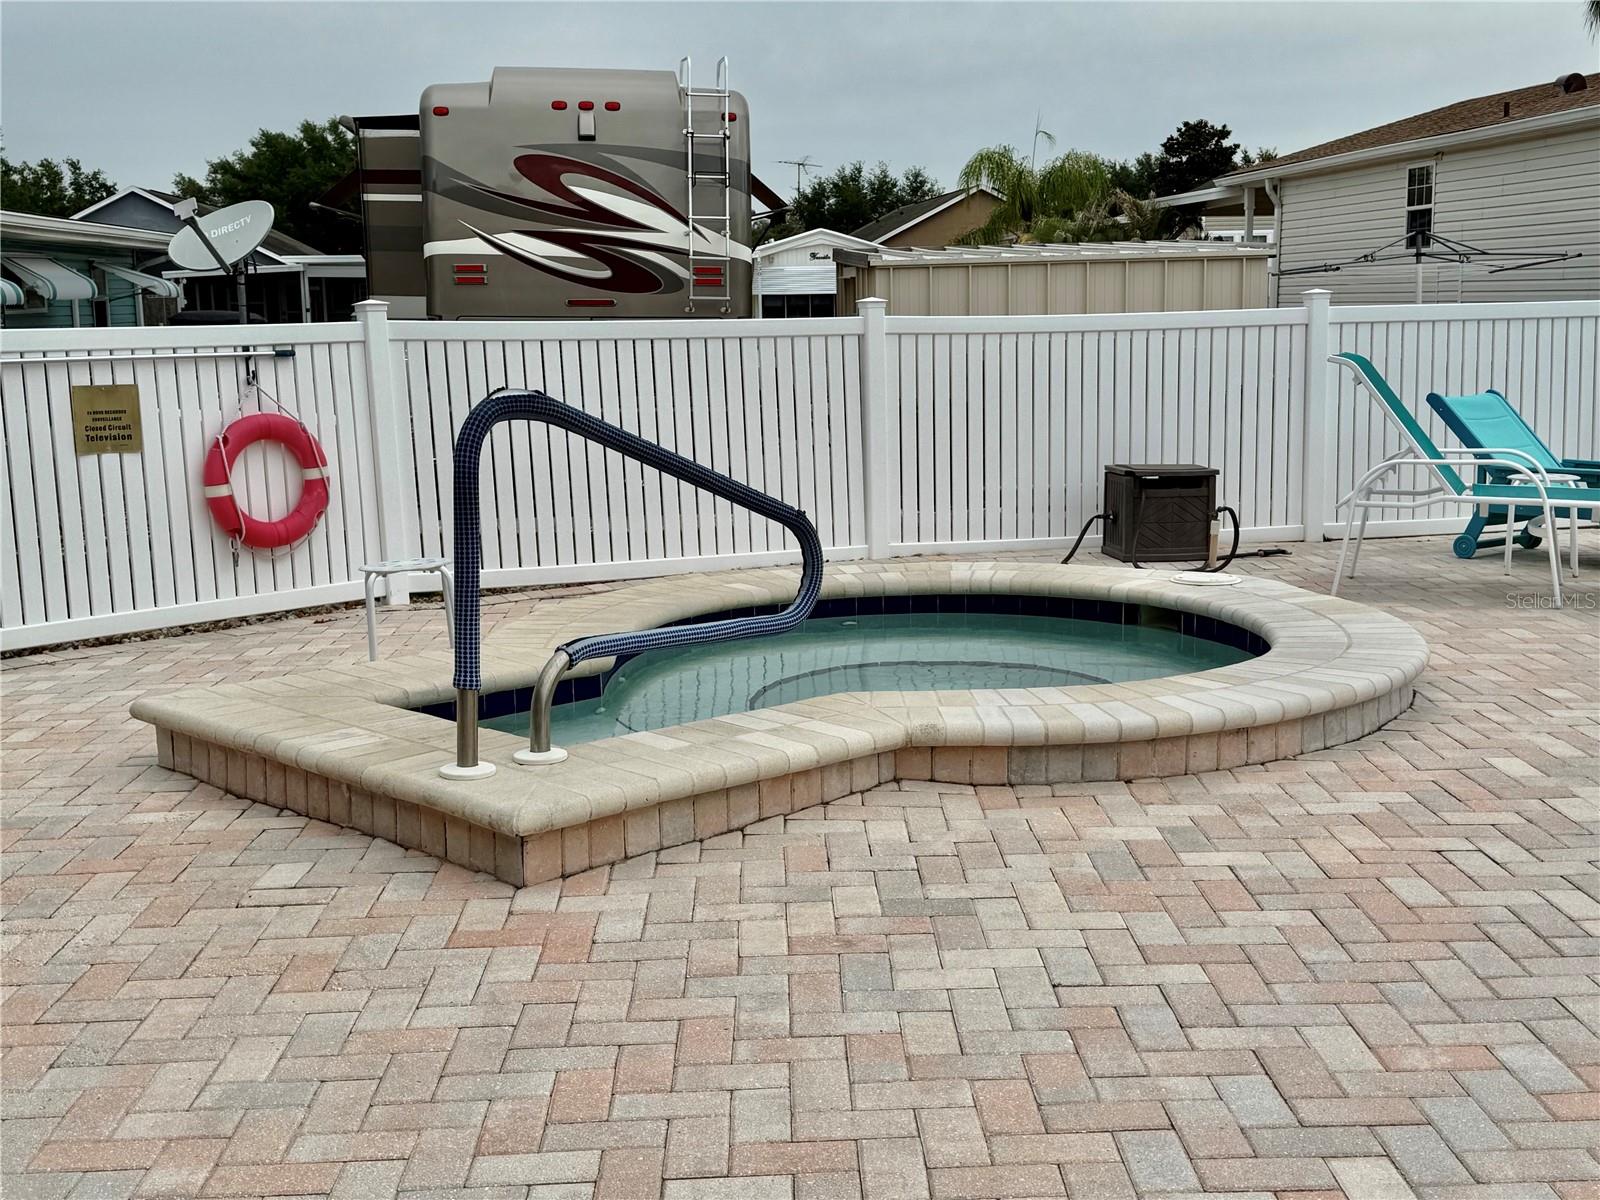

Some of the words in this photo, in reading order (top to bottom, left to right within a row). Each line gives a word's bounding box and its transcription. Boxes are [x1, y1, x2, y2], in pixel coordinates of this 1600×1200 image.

[210, 214, 252, 238] DIRECTV
[84, 424, 107, 432] Closed
[107, 423, 132, 431] Circuit
[85, 433, 133, 442] Television
